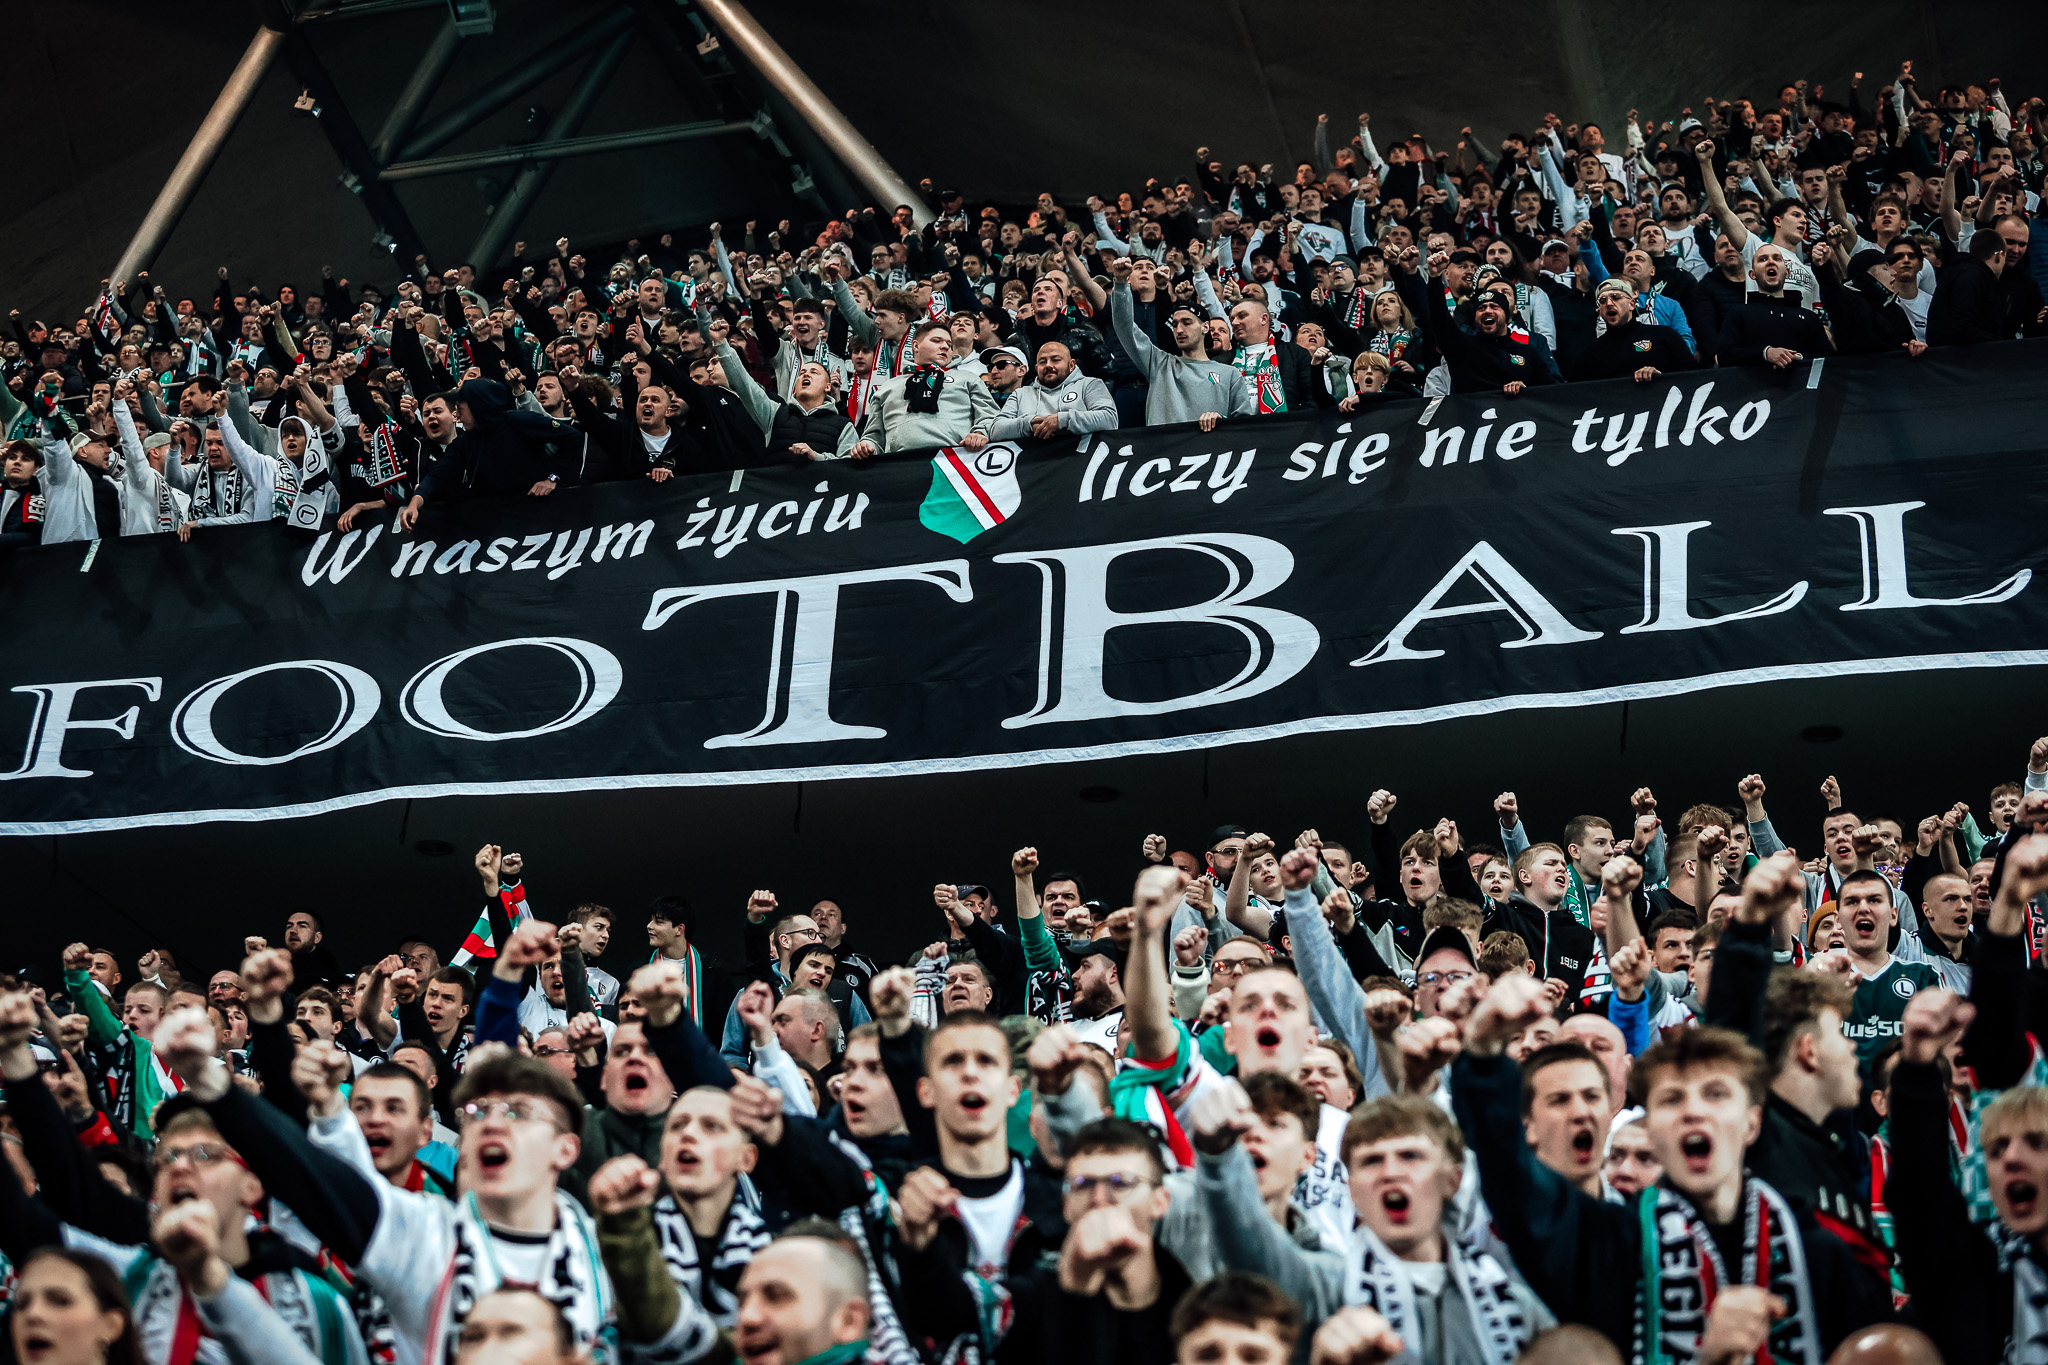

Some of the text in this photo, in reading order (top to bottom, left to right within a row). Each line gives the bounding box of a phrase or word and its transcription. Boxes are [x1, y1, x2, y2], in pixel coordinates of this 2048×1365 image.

[1079, 381, 1771, 504] liczy się nie tylko
[302, 480, 870, 587] W naszym życiu
[0, 501, 2032, 781] FOOTBALL
[1559, 955, 1580, 970] 1916
[1840, 1020, 1906, 1038] lus50
